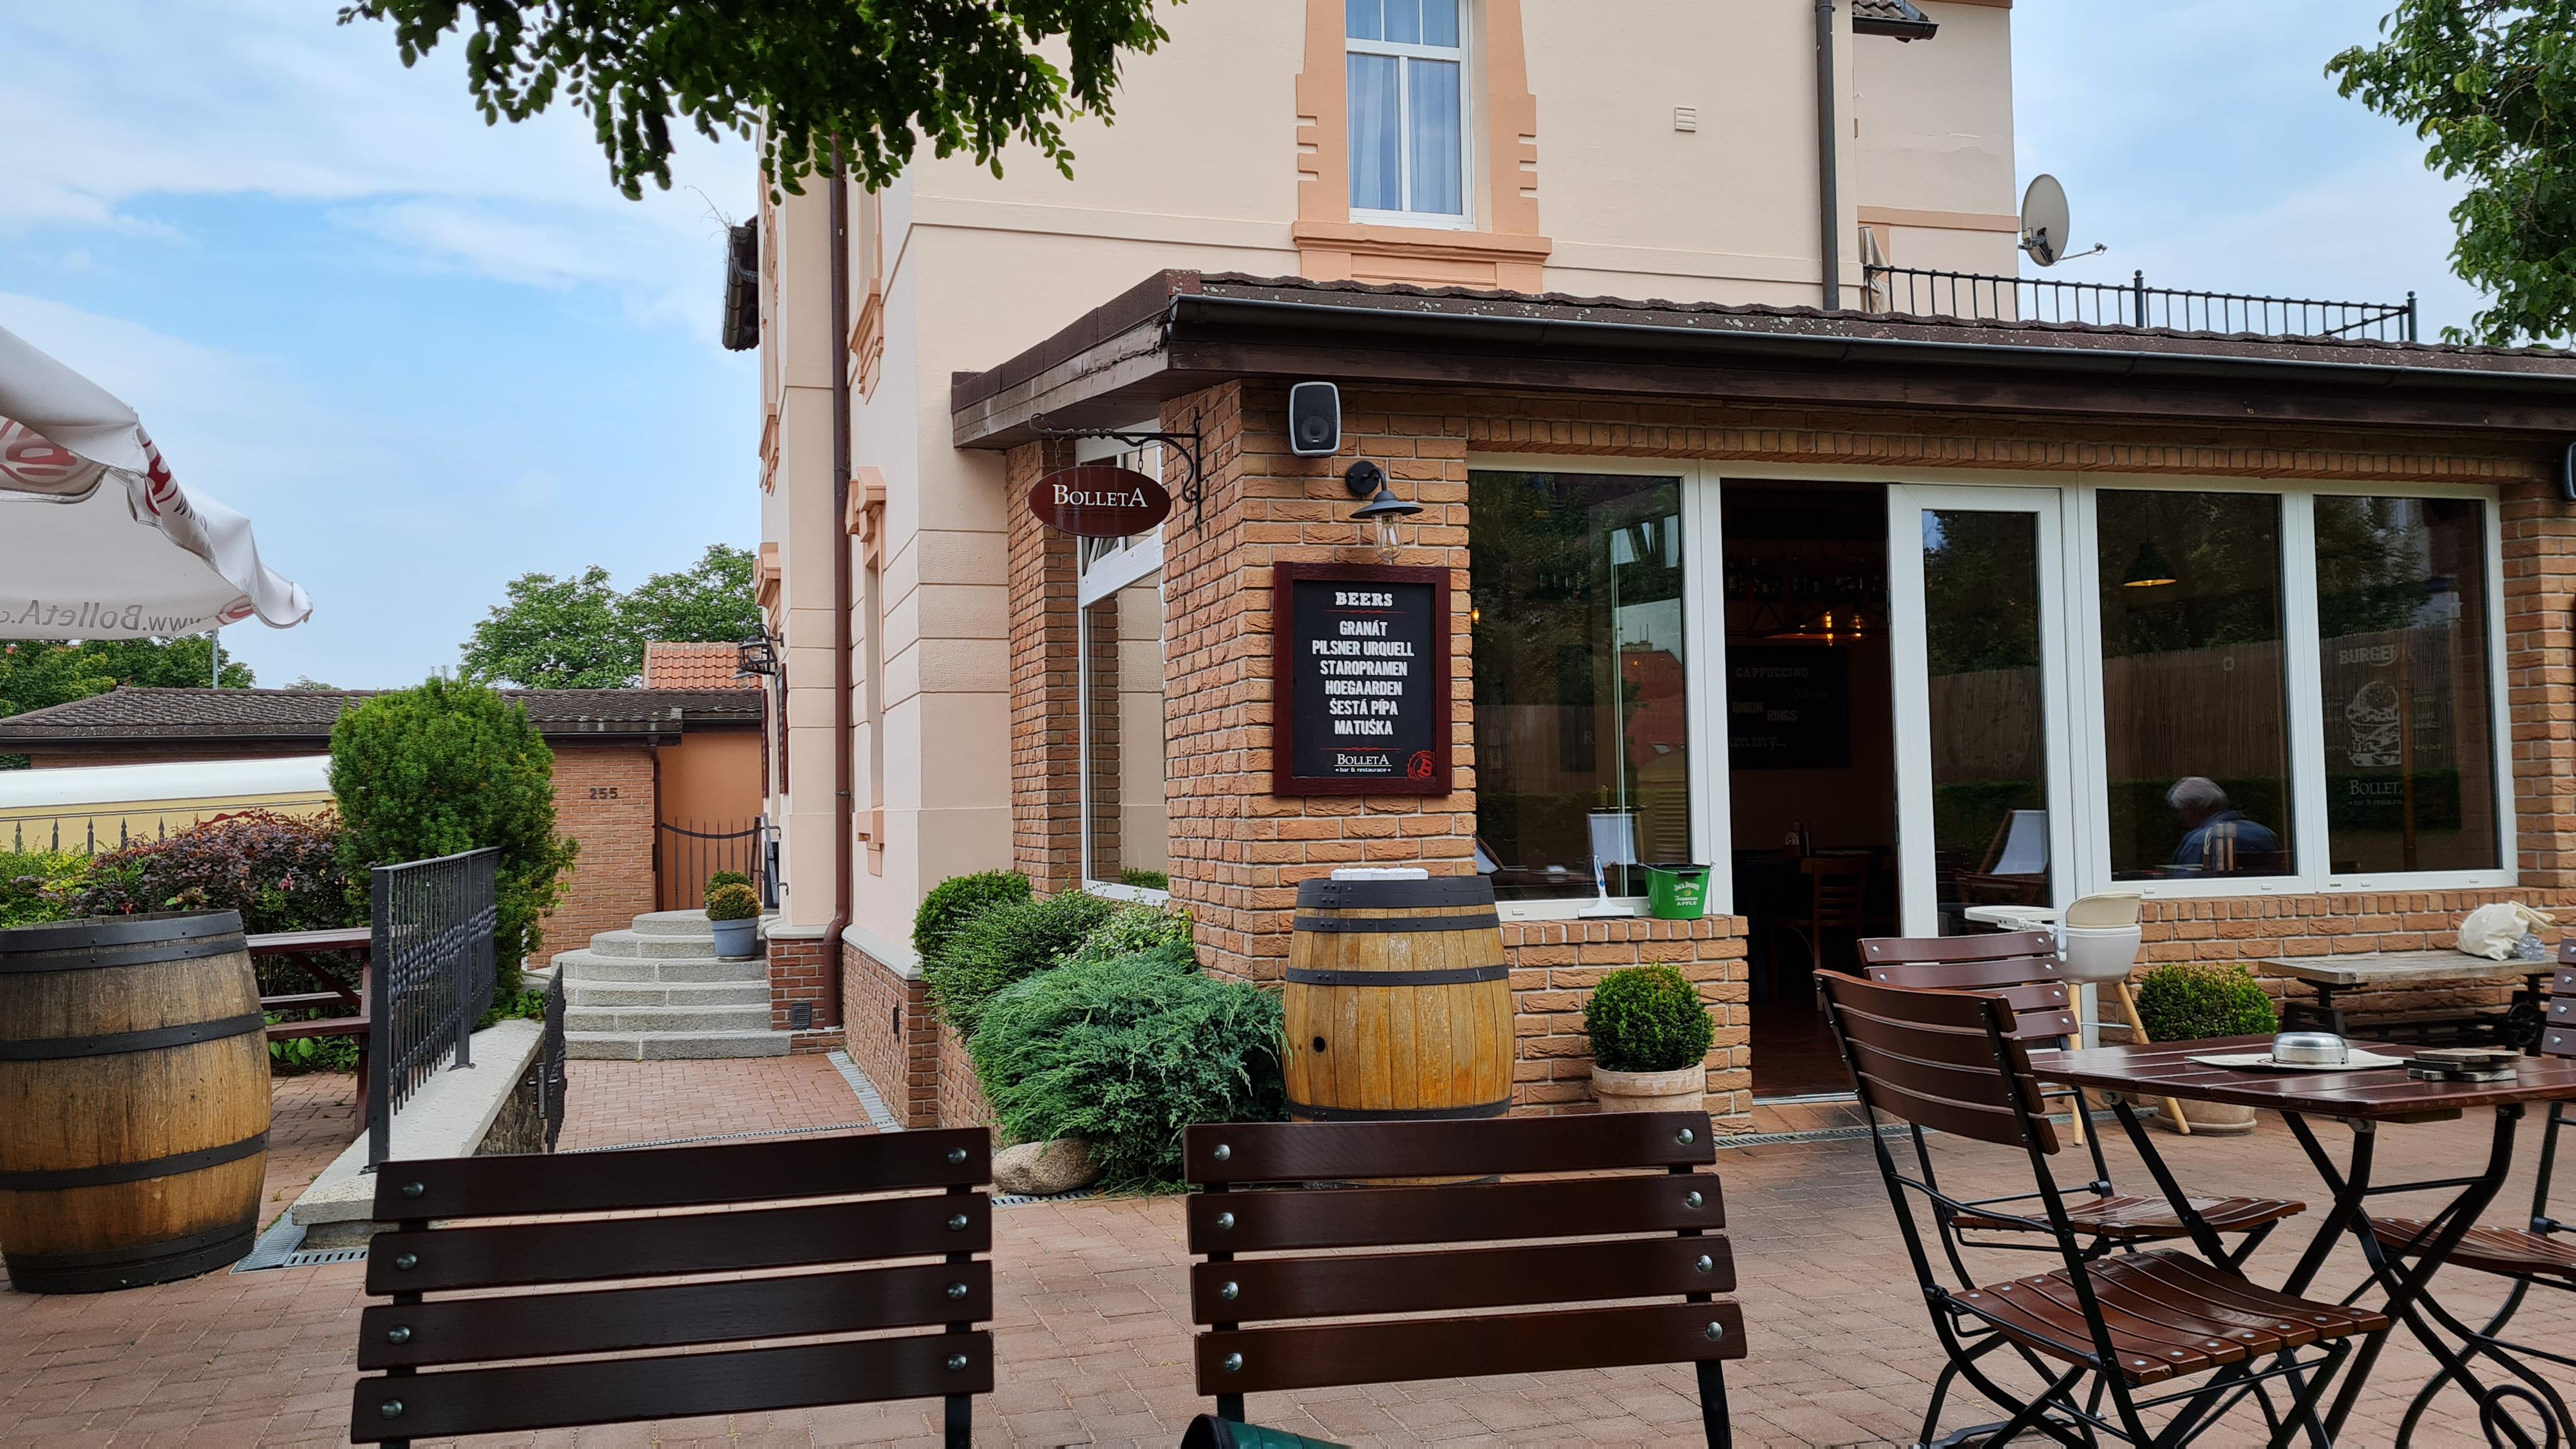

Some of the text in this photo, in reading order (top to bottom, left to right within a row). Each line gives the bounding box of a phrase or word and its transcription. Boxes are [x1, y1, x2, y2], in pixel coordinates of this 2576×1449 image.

[1052, 484, 1149, 507] BOLLETA
[1335, 591, 1393, 607] BEERS
[1340, 620, 1388, 636] GRANÁT
[1312, 639, 1415, 657] PILSNER URQUELL
[1320, 660, 1408, 676] STAROPRAMEN
[1736, 667, 1808, 678] CAPPUCCINO
[1325, 680, 1403, 696] HOEGAARDEN
[1329, 697, 1399, 715] ŠESTÁ PÍPA
[1732, 701, 1763, 714] ONION
[1766, 710, 1797, 721] RINGS
[1334, 718, 1394, 735] MATUŠKA
[1336, 753, 1390, 765] BOLLETA
[590, 788, 617, 799] 255
[2349, 780, 2403, 795] BOLLET
[1674, 883, 1685, 891] JACK
